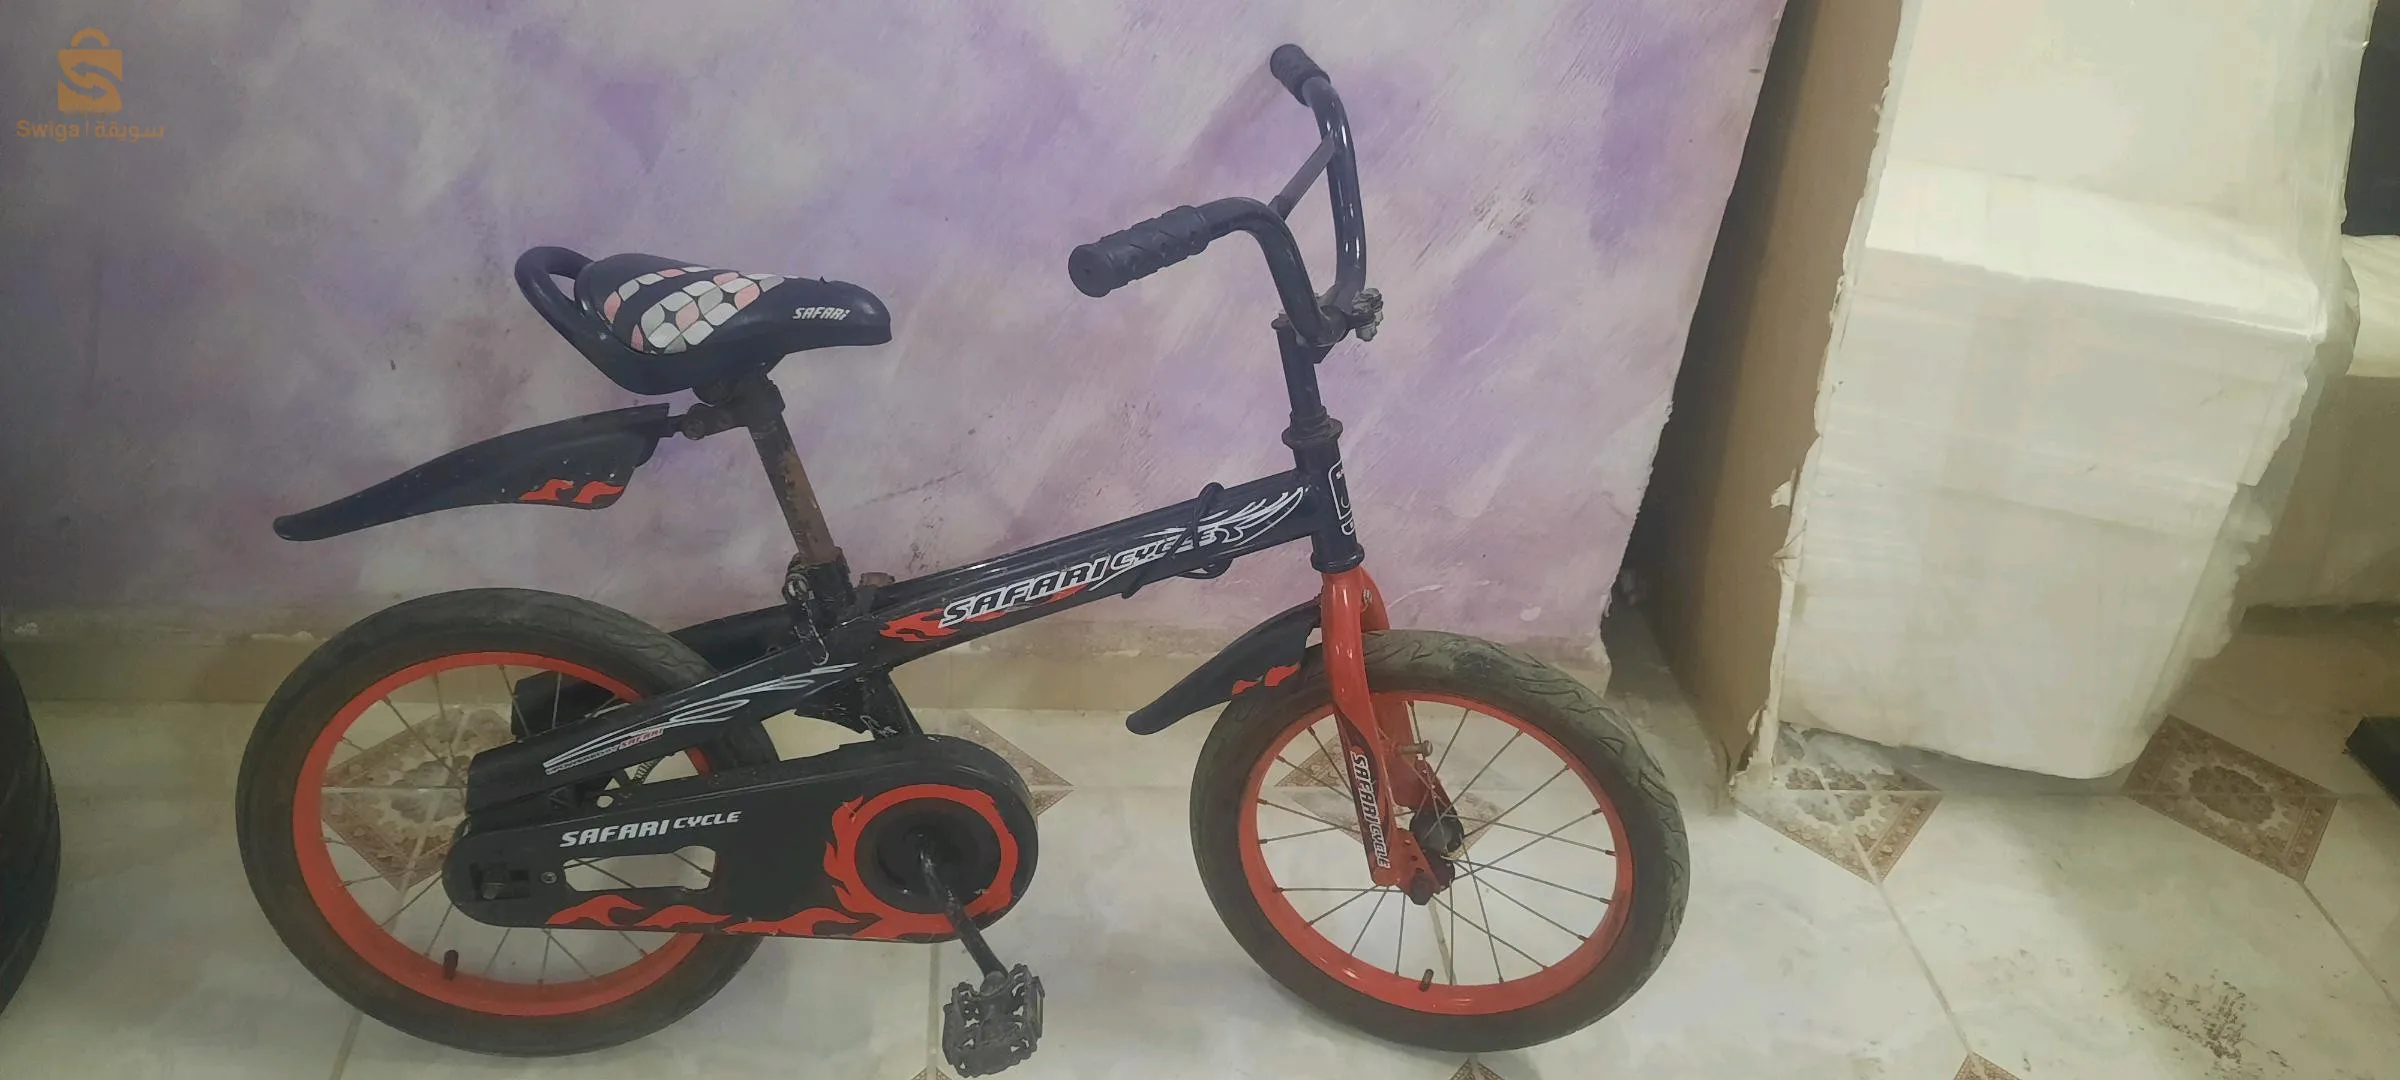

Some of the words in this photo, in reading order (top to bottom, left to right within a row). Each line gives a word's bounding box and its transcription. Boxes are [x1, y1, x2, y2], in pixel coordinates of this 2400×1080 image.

[938, 555, 1111, 629] SAFARI
[560, 819, 670, 847] SAFARI
[673, 811, 742, 829] CYCLE
[1350, 751, 1379, 824] SAFARI
[1369, 822, 1391, 868] CYCLE
